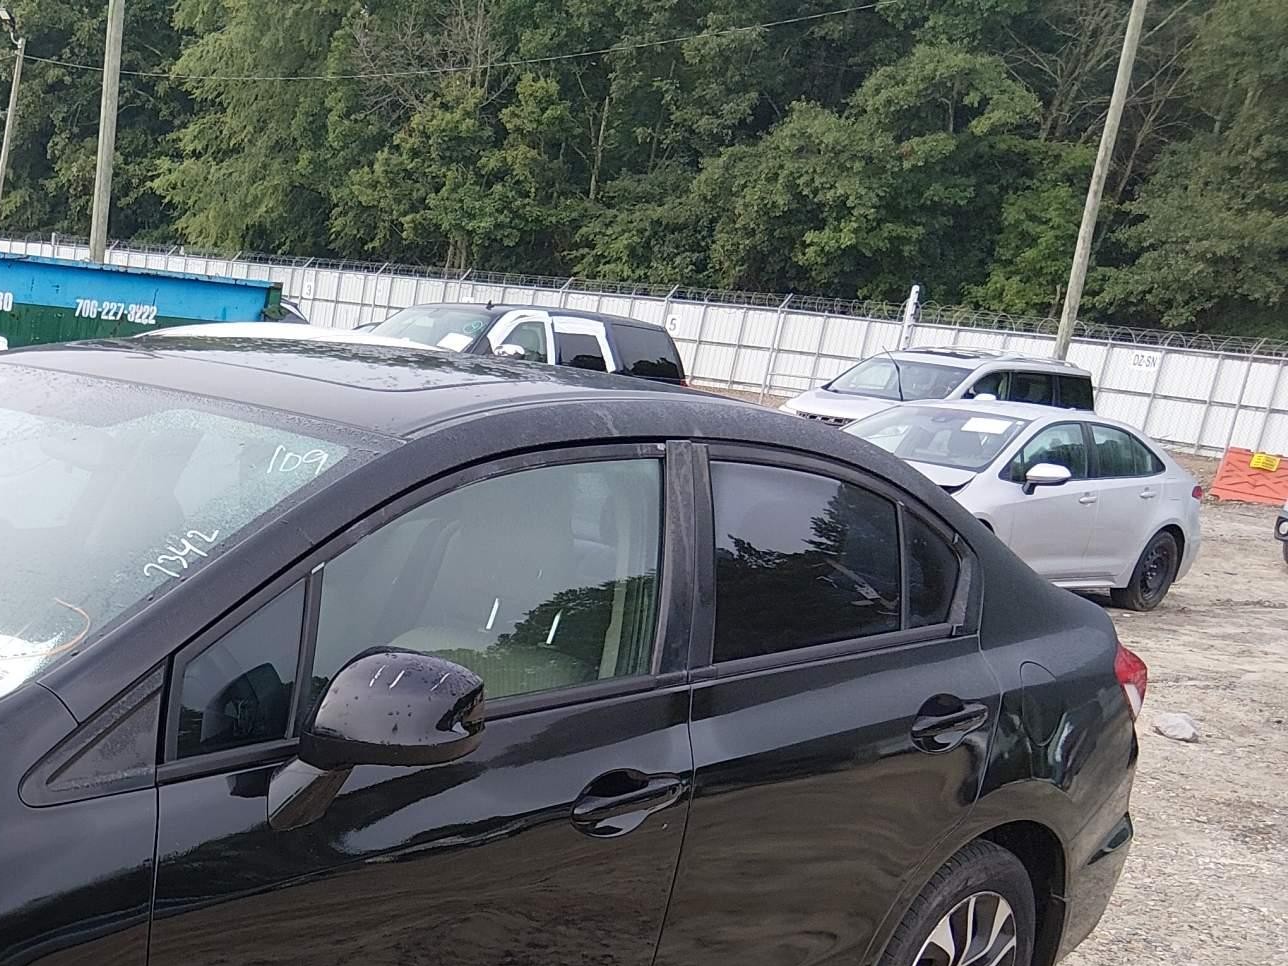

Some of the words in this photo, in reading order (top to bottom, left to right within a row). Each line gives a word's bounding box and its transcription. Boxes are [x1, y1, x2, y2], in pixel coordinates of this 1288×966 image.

[305, 284, 312, 297] 3
[668, 317, 677, 332] 5
[143, 529, 220, 578] 7342
